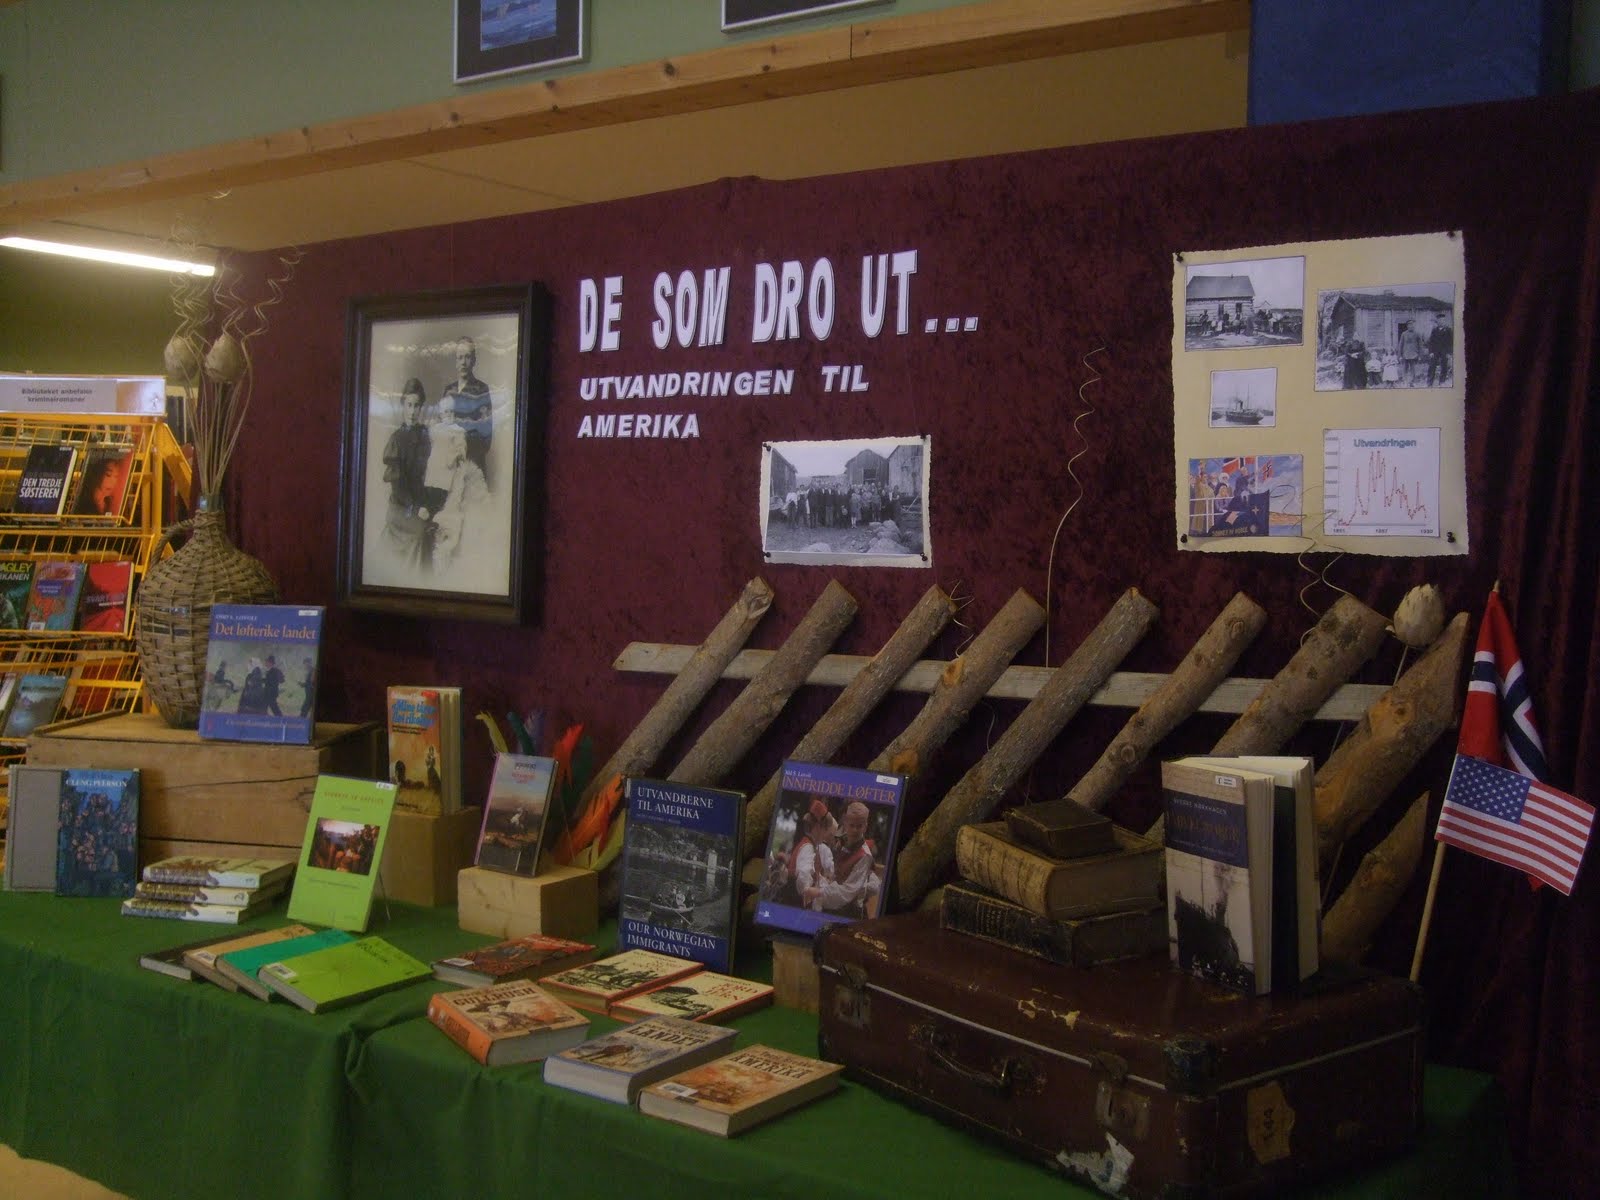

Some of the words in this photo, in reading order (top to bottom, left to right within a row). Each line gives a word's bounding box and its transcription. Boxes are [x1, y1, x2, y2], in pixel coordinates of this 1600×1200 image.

[579, 275, 623, 353] DE
[652, 266, 731, 350] SOM
[752, 257, 836, 342] DRO
[579, 369, 795, 401] UTVANDRINGEN
[821, 364, 870, 393] TIL
[577, 413, 700, 439] AMERIKA
[19, 486, 61, 499] SØSTEREN
[22, 478, 37, 488] DEN
[38, 477, 63, 488] TREDJE
[215, 622, 233, 636] Det
[236, 623, 280, 638] løfterike
[282, 624, 316, 640] landet
[637, 786, 714, 809] UTVANDRERNE
[782, 775, 846, 797] INNFRIDDE
[848, 784, 897, 803] LØFTER
[637, 799, 653, 811] TIL
[654, 803, 700, 820] AMERIKA
[627, 933, 691, 957] IMMIGRANTS
[628, 921, 650, 935] OUR
[653, 926, 716, 950] NORWEGIAN
[626, 1025, 705, 1046] LANDET
[728, 1053, 814, 1079] AMERIKA
